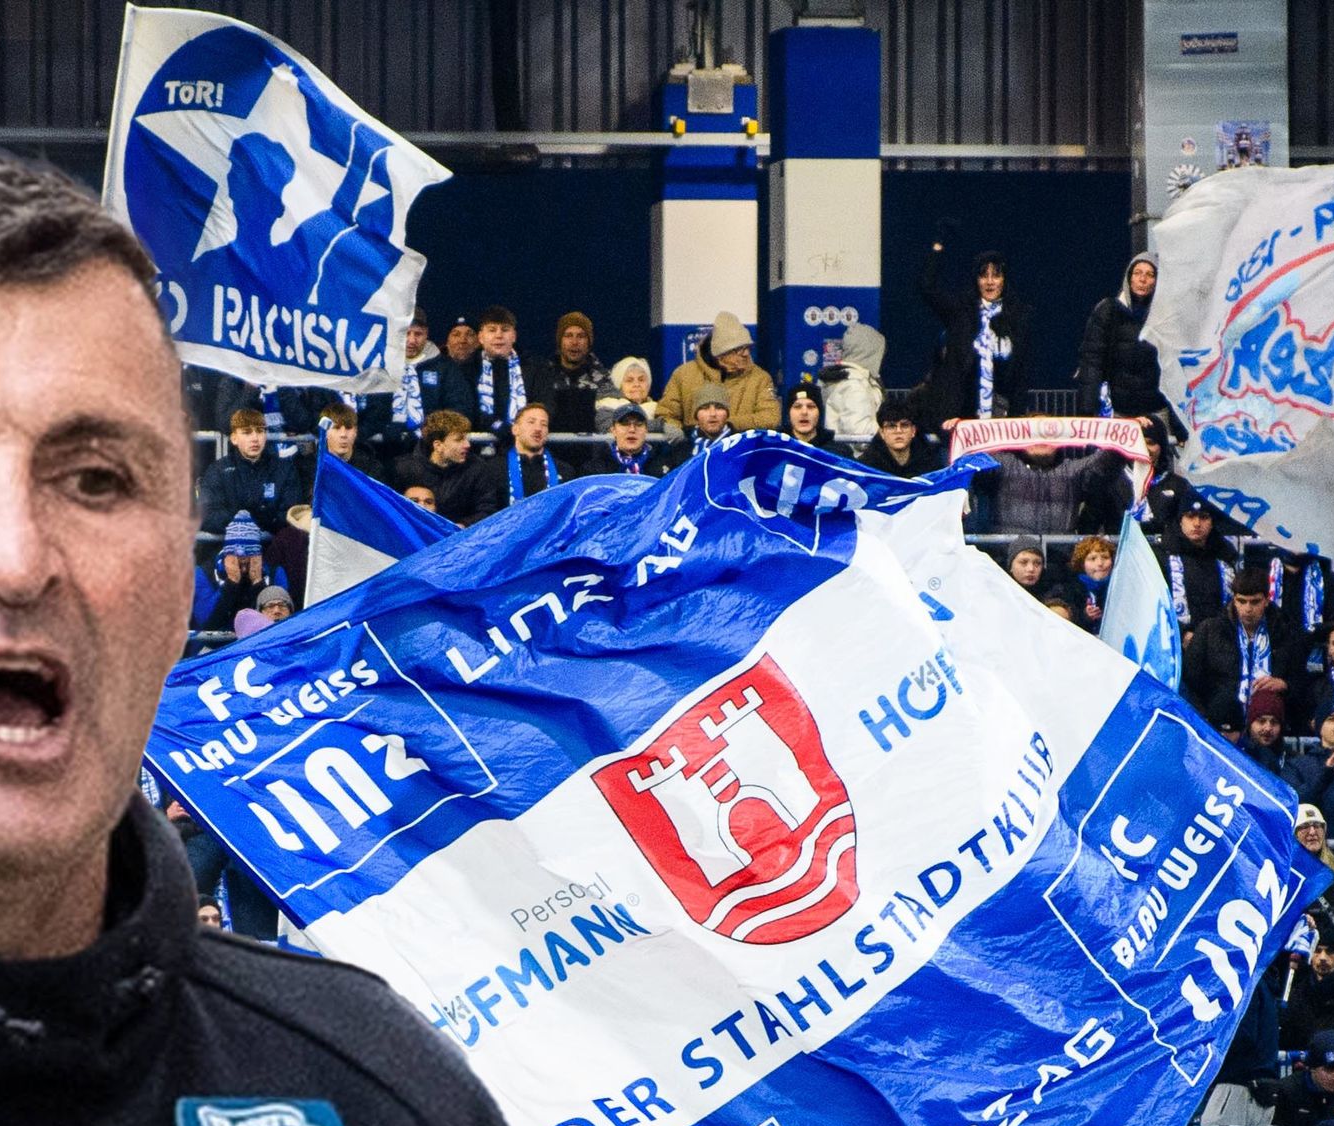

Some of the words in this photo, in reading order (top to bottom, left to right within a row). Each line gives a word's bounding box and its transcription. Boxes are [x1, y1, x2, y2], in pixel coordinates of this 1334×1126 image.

[154, 280, 188, 335] O
[956, 420, 1032, 450] TRADITION
[1069, 419, 1104, 440] SEIT
[1104, 421, 1139, 447] 1889
[445, 572, 615, 685] LINZ
[636, 514, 704, 588] AG
[197, 655, 274, 722] FC
[261, 658, 380, 727] WEISS
[247, 732, 432, 856] LINZ
[1111, 886, 1168, 969] BLAU
[1157, 776, 1245, 891] WEISS
[1181, 858, 1288, 1023] LINZ
[1033, 1017, 1116, 1104] AG
